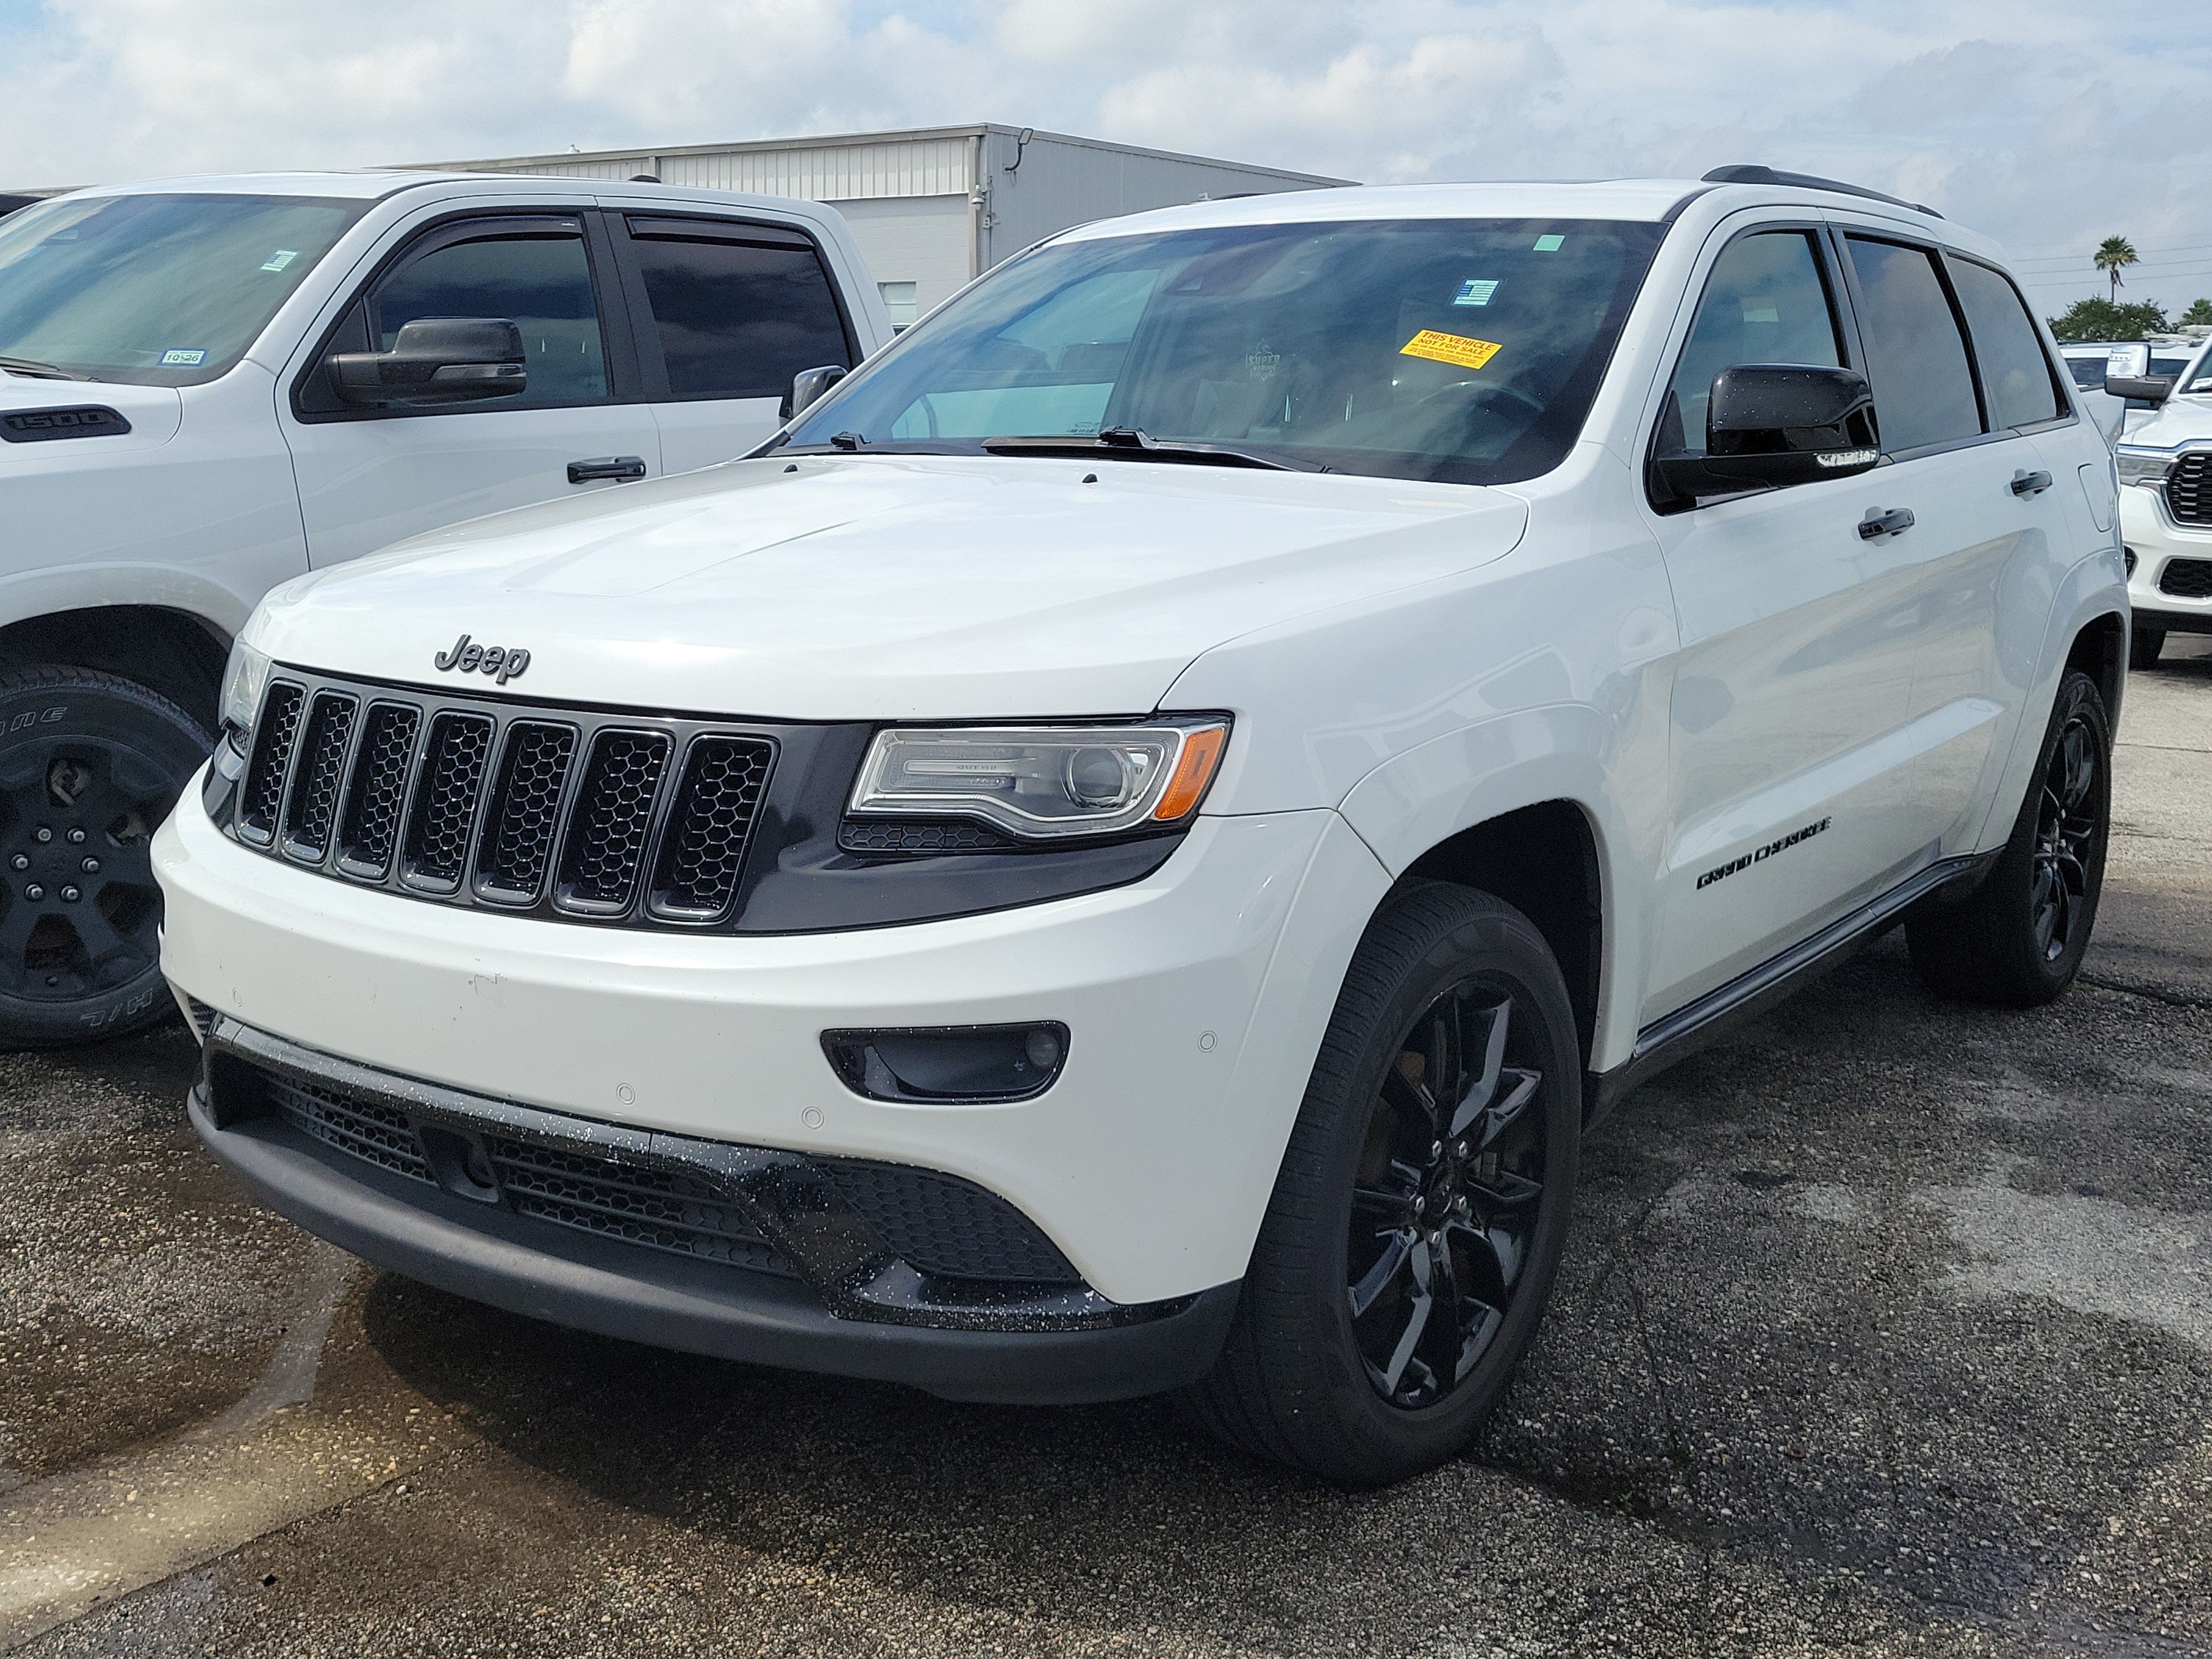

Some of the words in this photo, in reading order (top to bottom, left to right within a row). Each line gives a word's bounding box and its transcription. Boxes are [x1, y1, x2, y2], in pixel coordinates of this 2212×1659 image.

[1418, 338, 1439, 346] NOT
[1439, 342, 1460, 350] FOR
[1461, 346, 1486, 356] SALE
[1422, 331, 1447, 341] THIS
[1449, 336, 1496, 351] VEHICLE
[5, 411, 108, 430] 1500
[435, 634, 531, 685] Jeep
[1696, 853, 1752, 890] GRAND
[1754, 816, 1832, 863] CHEROKEE
